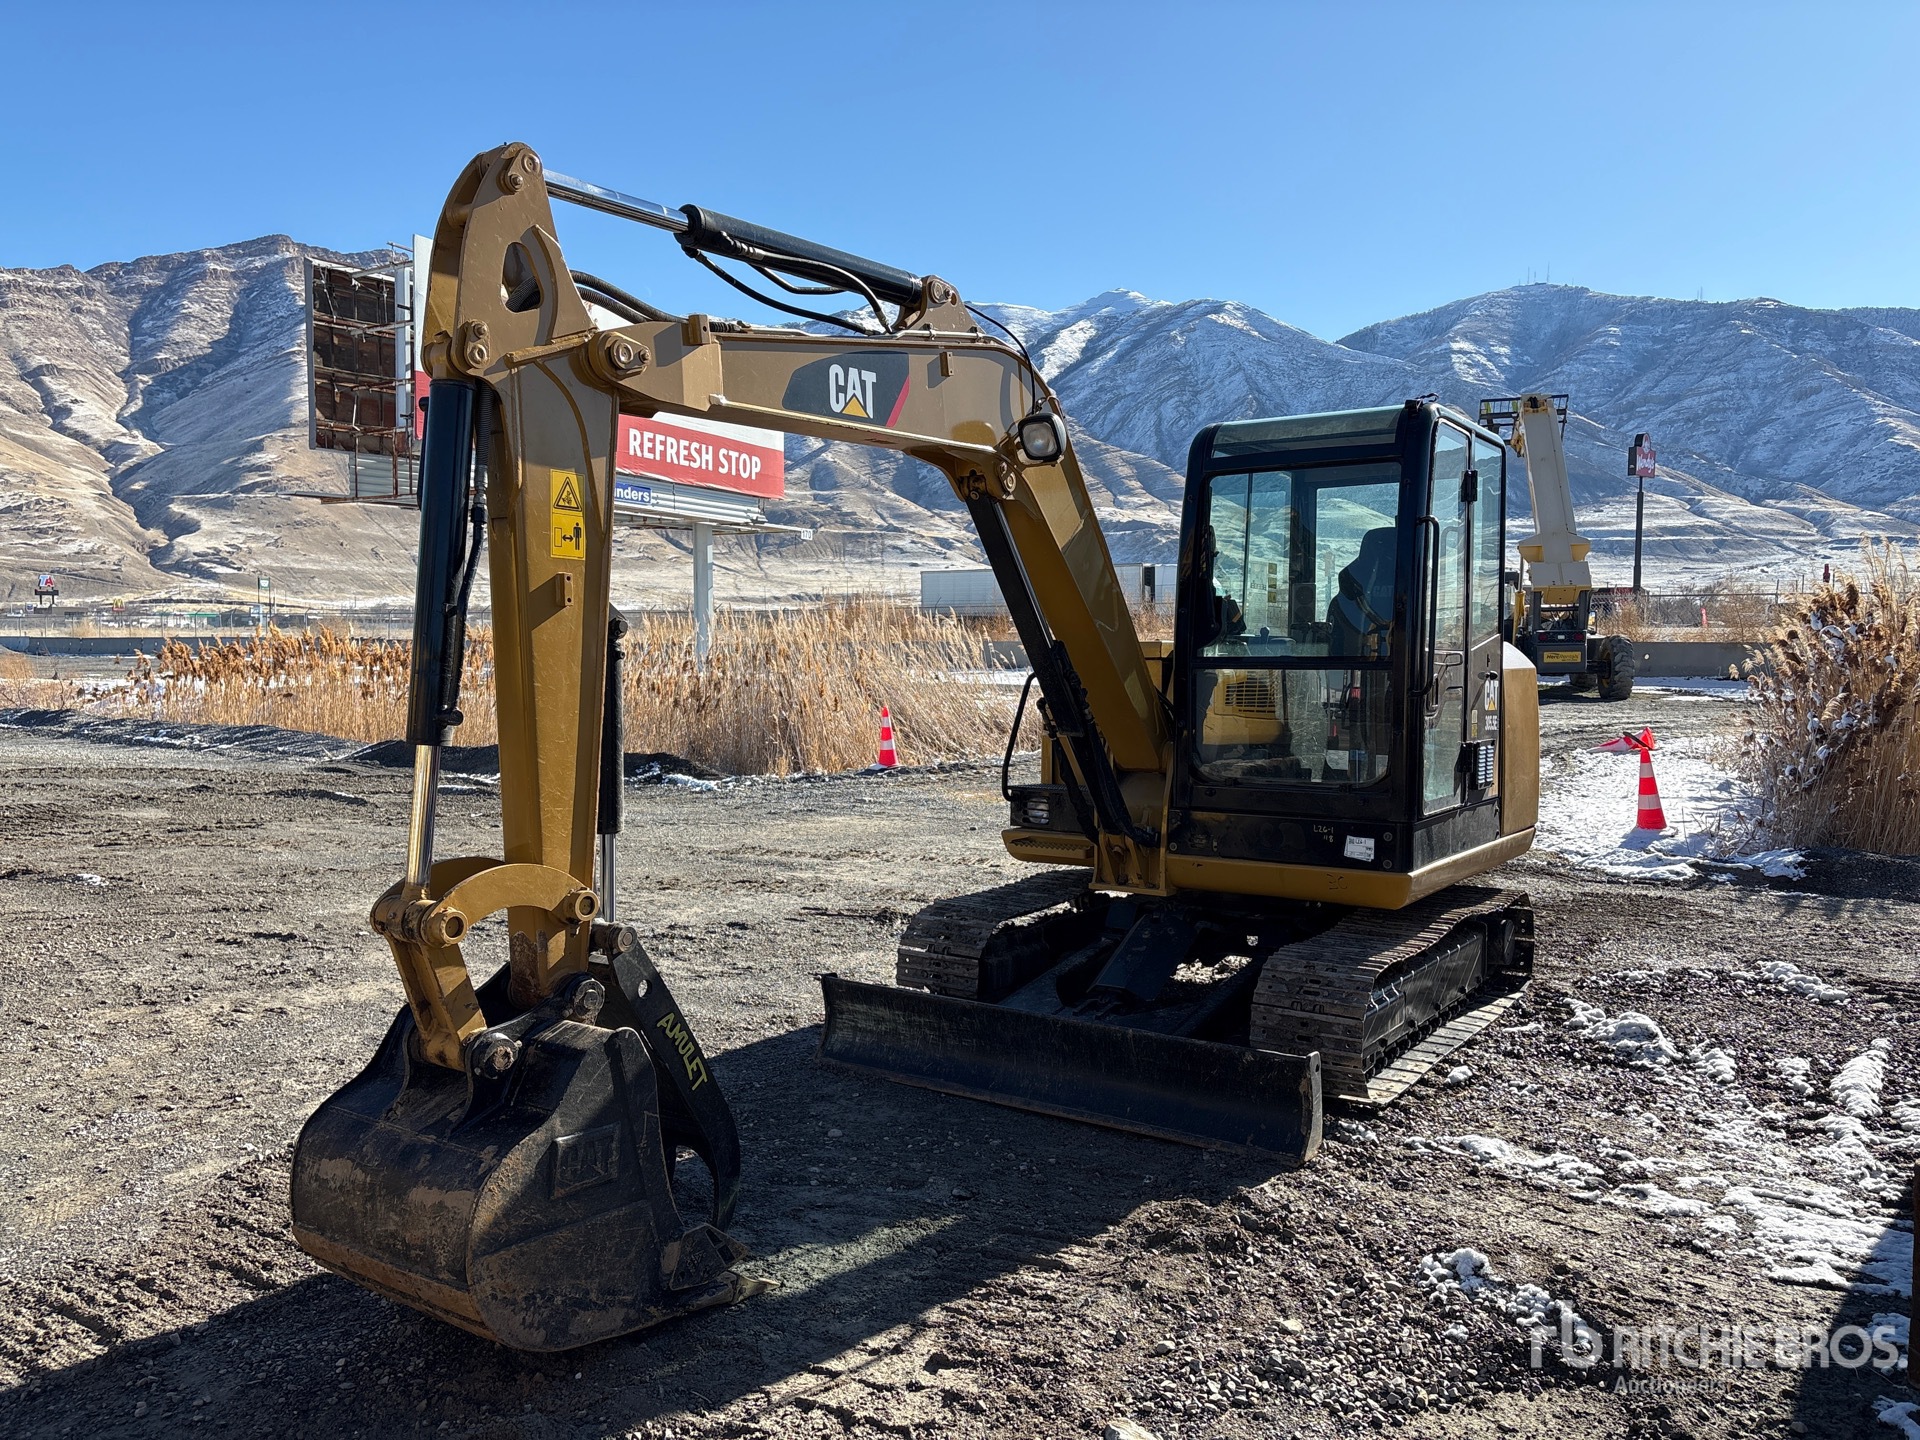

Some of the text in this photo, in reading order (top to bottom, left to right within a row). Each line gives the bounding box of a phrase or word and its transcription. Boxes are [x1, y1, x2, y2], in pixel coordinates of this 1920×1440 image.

[829, 363, 876, 419] CAT
[628, 428, 762, 480] REFRESH STOP
[39, 574, 54, 587] TA
[1484, 680, 1499, 711] CAT
[656, 1012, 708, 1091] AMULET
[562, 1135, 613, 1183] CAT
